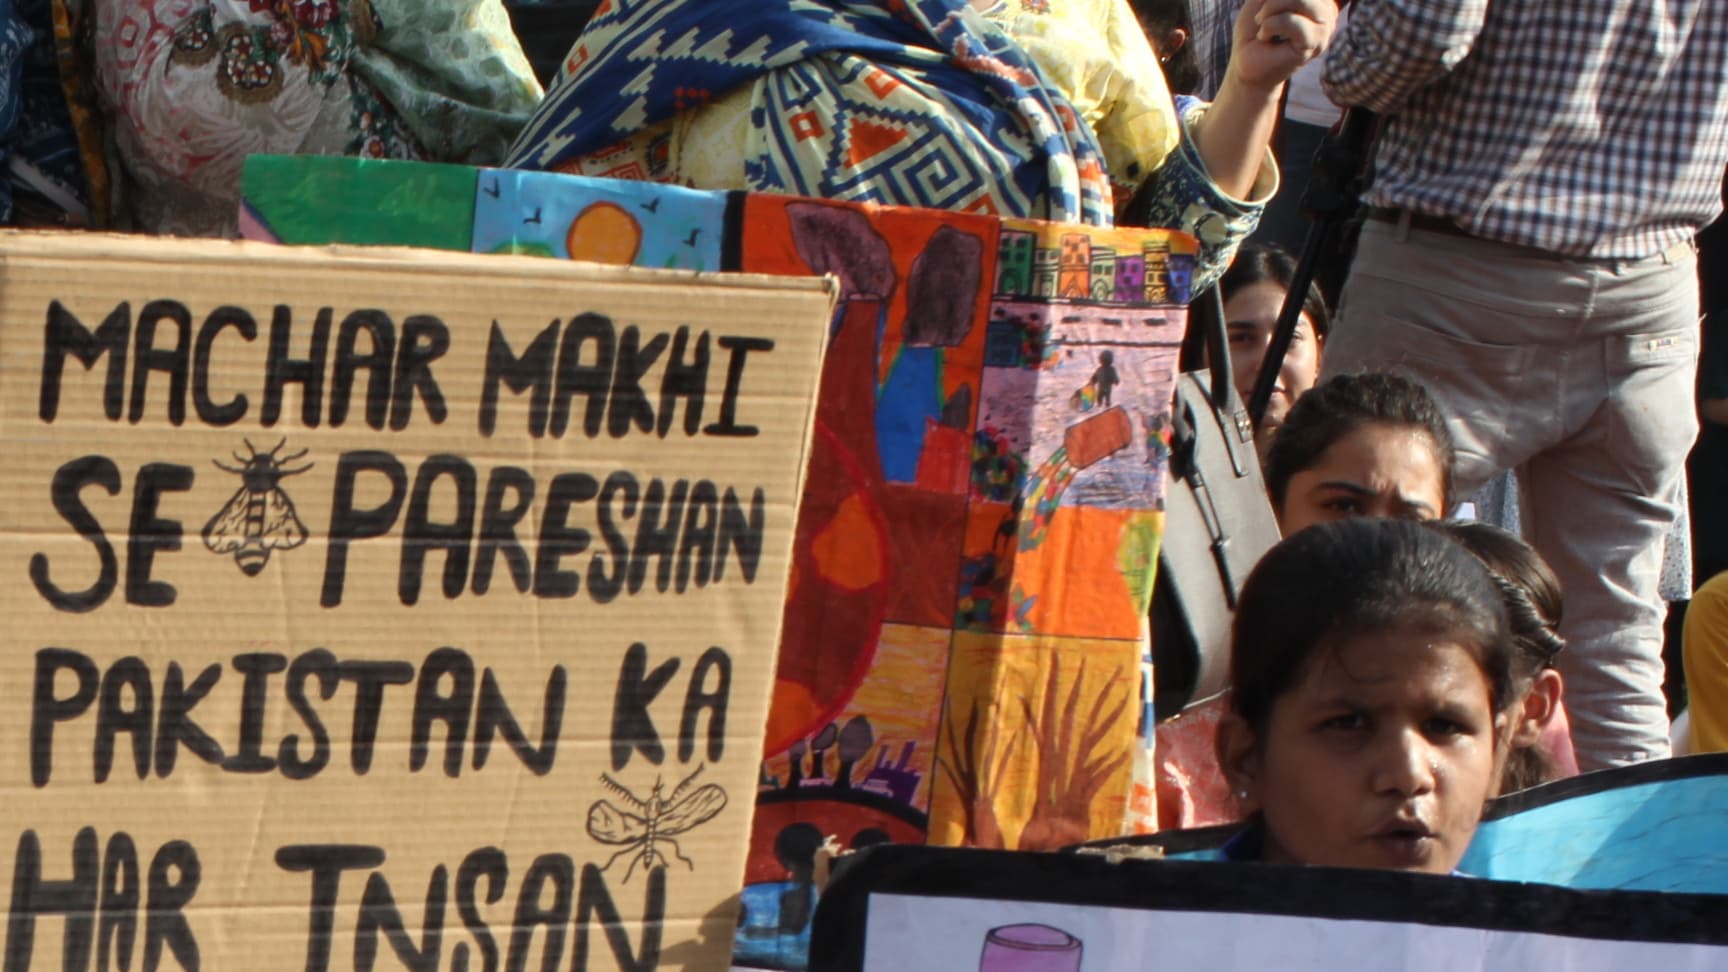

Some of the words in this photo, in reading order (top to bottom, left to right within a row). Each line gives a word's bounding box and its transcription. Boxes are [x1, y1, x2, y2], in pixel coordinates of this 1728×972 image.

[38, 298, 451, 432] MACHAR
[478, 311, 775, 440] MAKHI
[29, 453, 196, 614] SE
[319, 449, 766, 608] PARESHAN
[30, 644, 566, 788] PAKISTAN
[611, 641, 733, 773] KA
